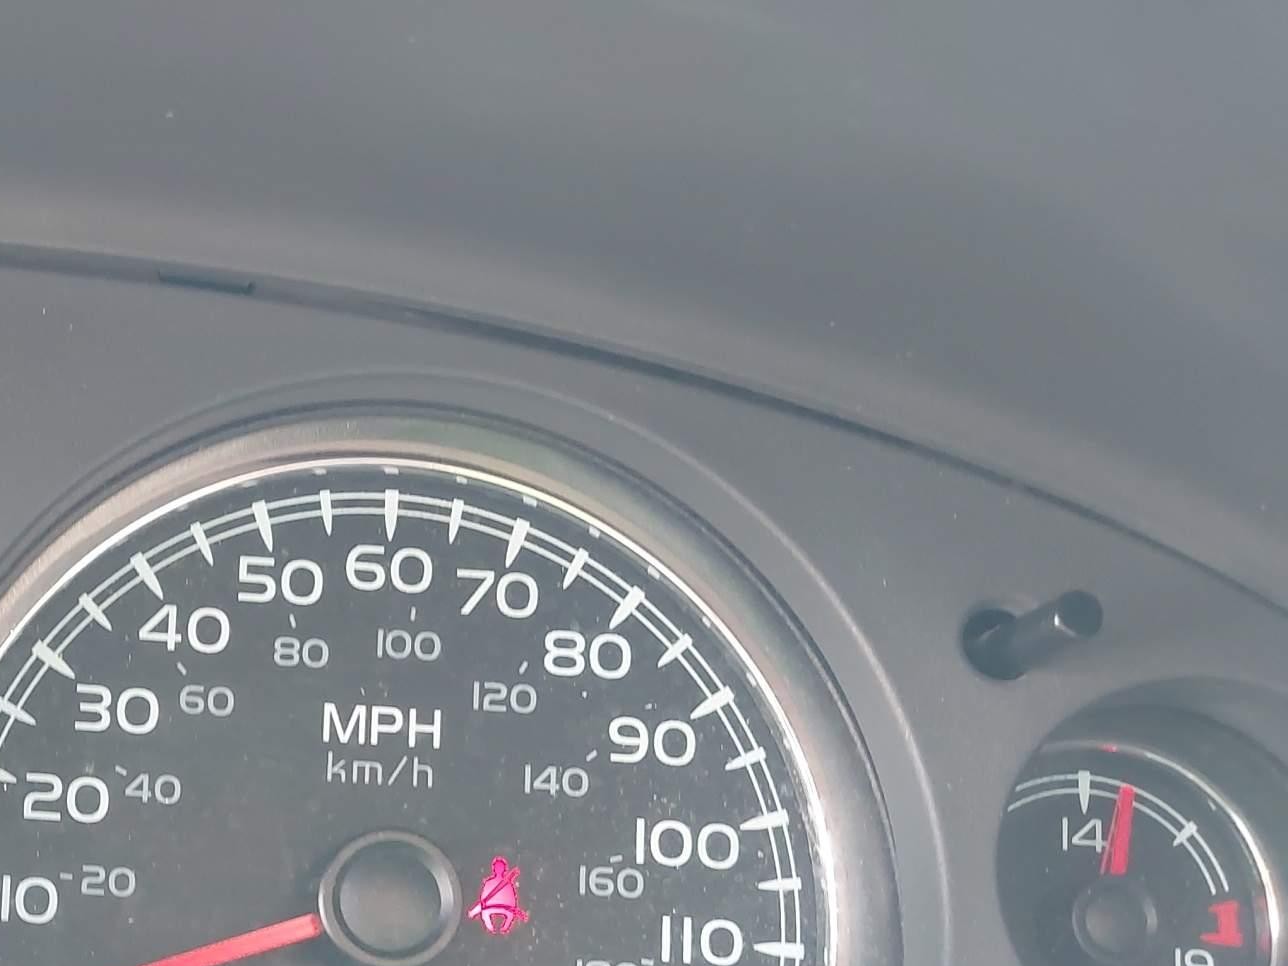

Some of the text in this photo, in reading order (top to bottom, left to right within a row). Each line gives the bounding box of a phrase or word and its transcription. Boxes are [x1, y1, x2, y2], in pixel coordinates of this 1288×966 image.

[238, 555, 324, 605] 50
[346, 544, 433, 594] 60
[456, 568, 539, 619] 70
[138, 604, 230, 654] 40
[273, 636, 329, 669] 80
[377, 629, 441, 662] 100
[543, 629, 632, 679] 80
[74, 683, 160, 735] 30
[180, 685, 235, 716] 60
[473, 681, 538, 715] 120
[322, 703, 442, 749] MPH
[608, 715, 697, 767] 90
[124, 774, 181, 805] 40
[326, 751, 433, 788] km/h
[524, 763, 589, 798] 140
[23, 772, 110, 823] 20
[635, 818, 740, 870] 100
[1062, 817, 1109, 853] 14
[0, 874, 58, 924] 10
[81, 864, 136, 897] 20
[579, 865, 644, 900] 160
[661, 915, 743, 966] 110
